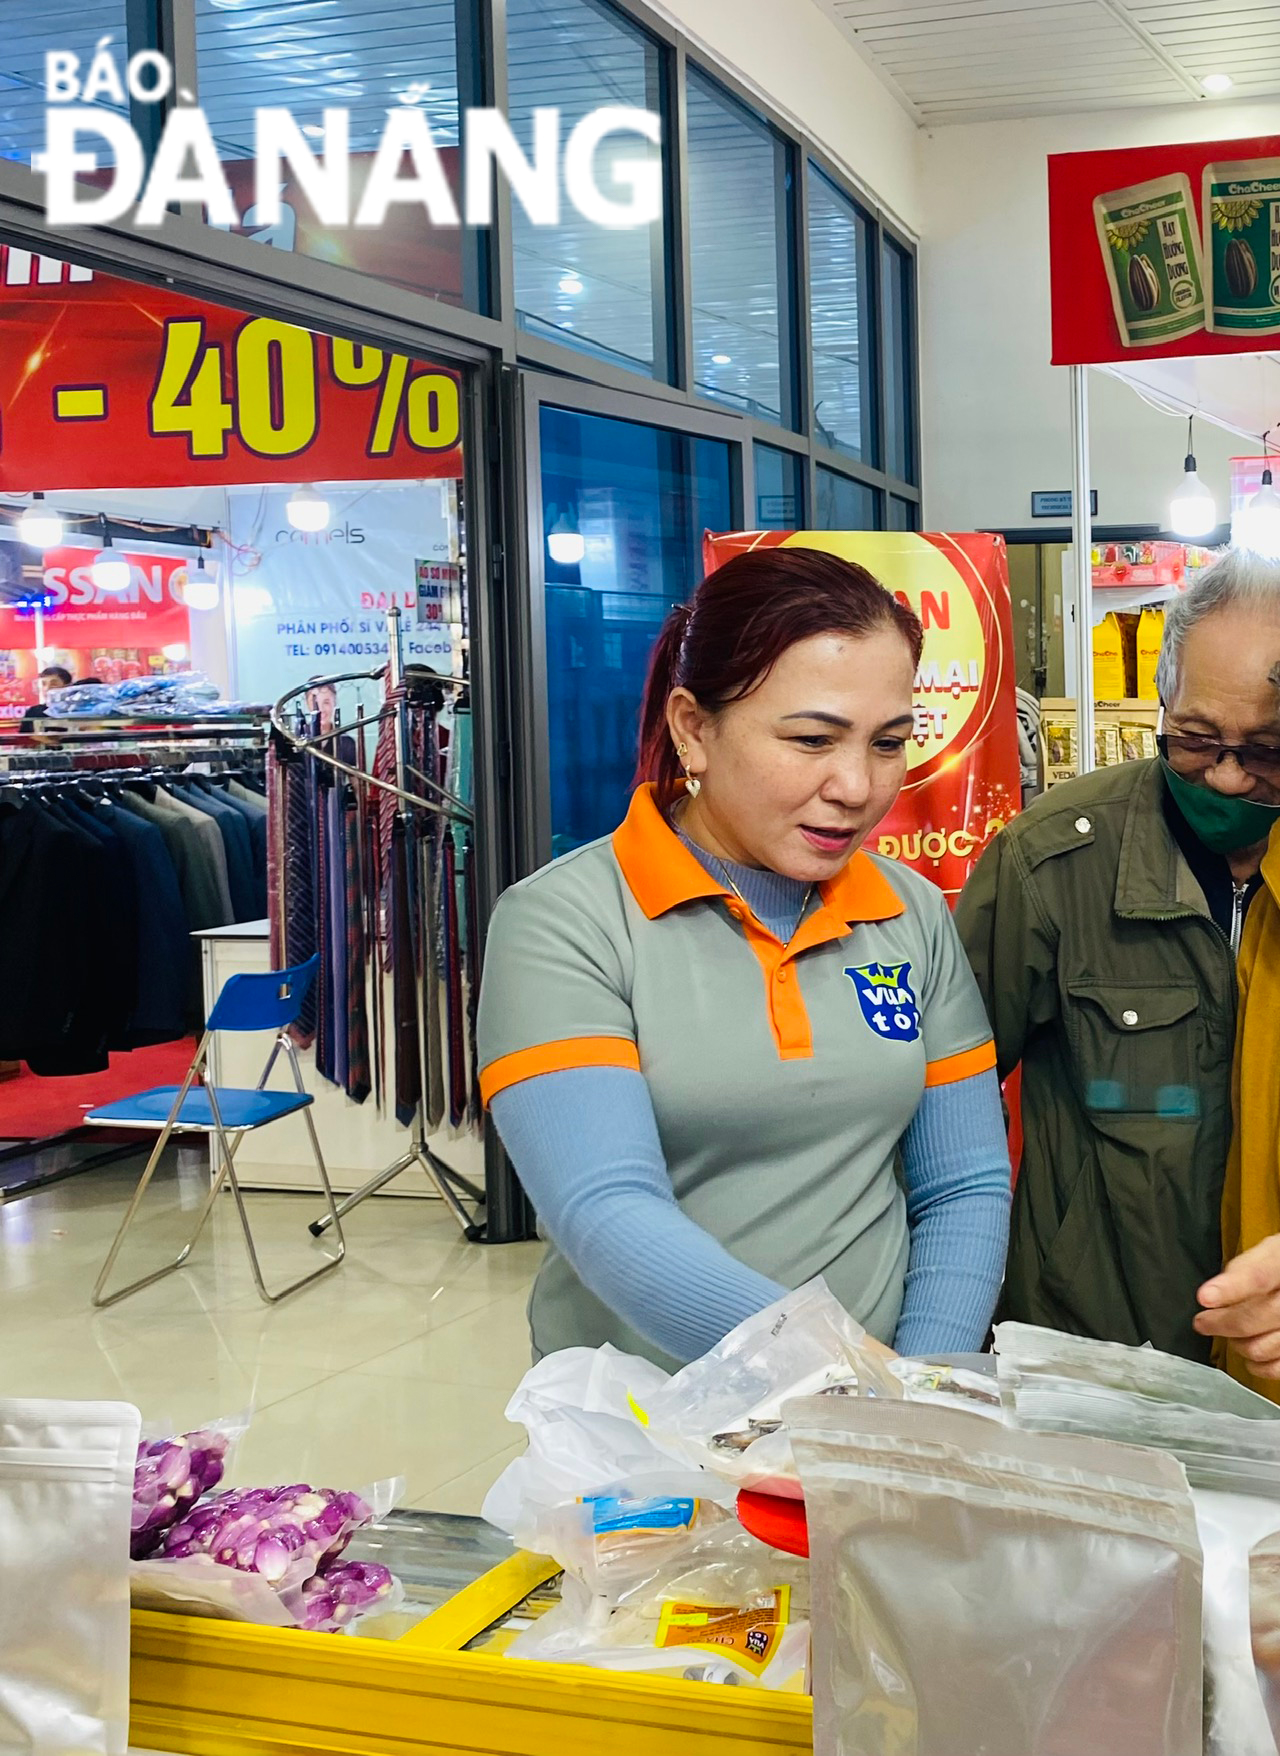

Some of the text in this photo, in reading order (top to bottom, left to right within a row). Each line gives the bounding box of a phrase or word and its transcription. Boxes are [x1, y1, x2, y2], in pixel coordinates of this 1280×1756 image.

[315, 643, 390, 656] 091400534
[408, 642, 452, 655] Faceb
[1053, 771, 1076, 780] VEDA
[878, 827, 974, 867] ĐƯỢC
